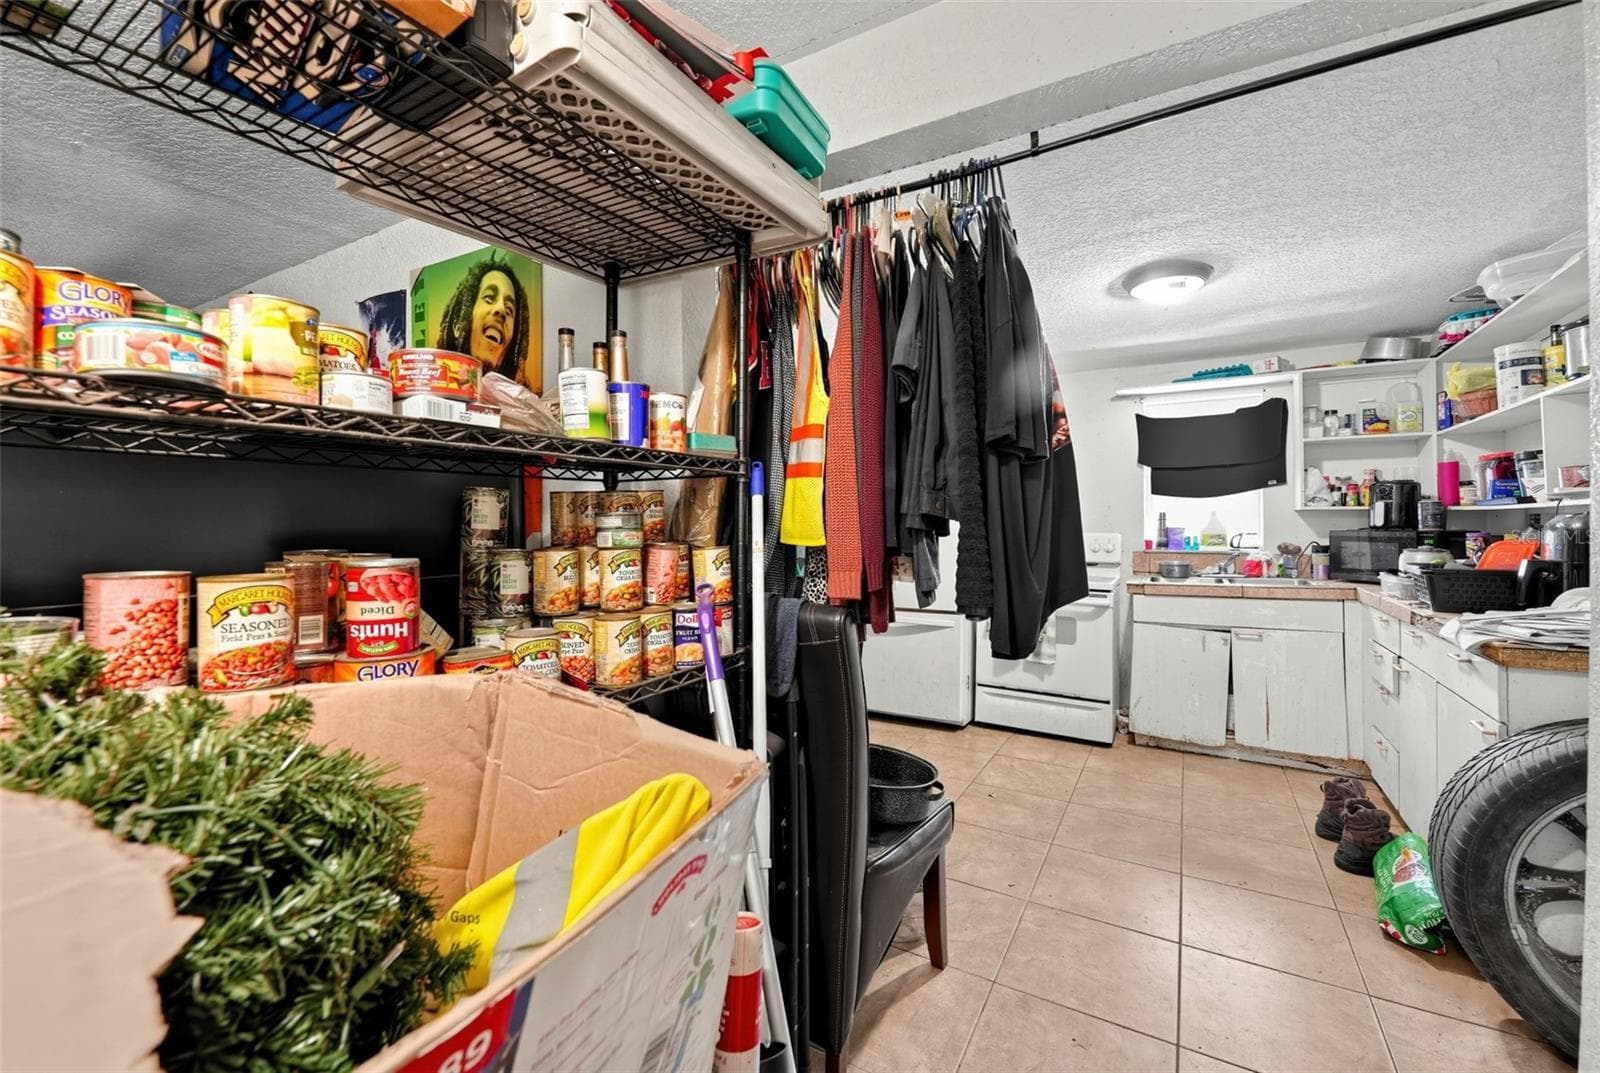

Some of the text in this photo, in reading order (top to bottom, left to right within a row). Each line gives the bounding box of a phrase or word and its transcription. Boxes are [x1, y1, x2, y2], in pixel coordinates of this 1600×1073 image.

[59, 281, 131, 313] GLORY
[50, 305, 117, 320] SEASO
[320, 359, 357, 371] MATOES
[219, 590, 265, 605] MARGARET
[360, 605, 395, 616] Diced
[221, 633, 243, 643] Field
[350, 621, 408, 641] Hunt's
[357, 659, 419, 681] GLORY
[450, 911, 480, 924] Gaps
